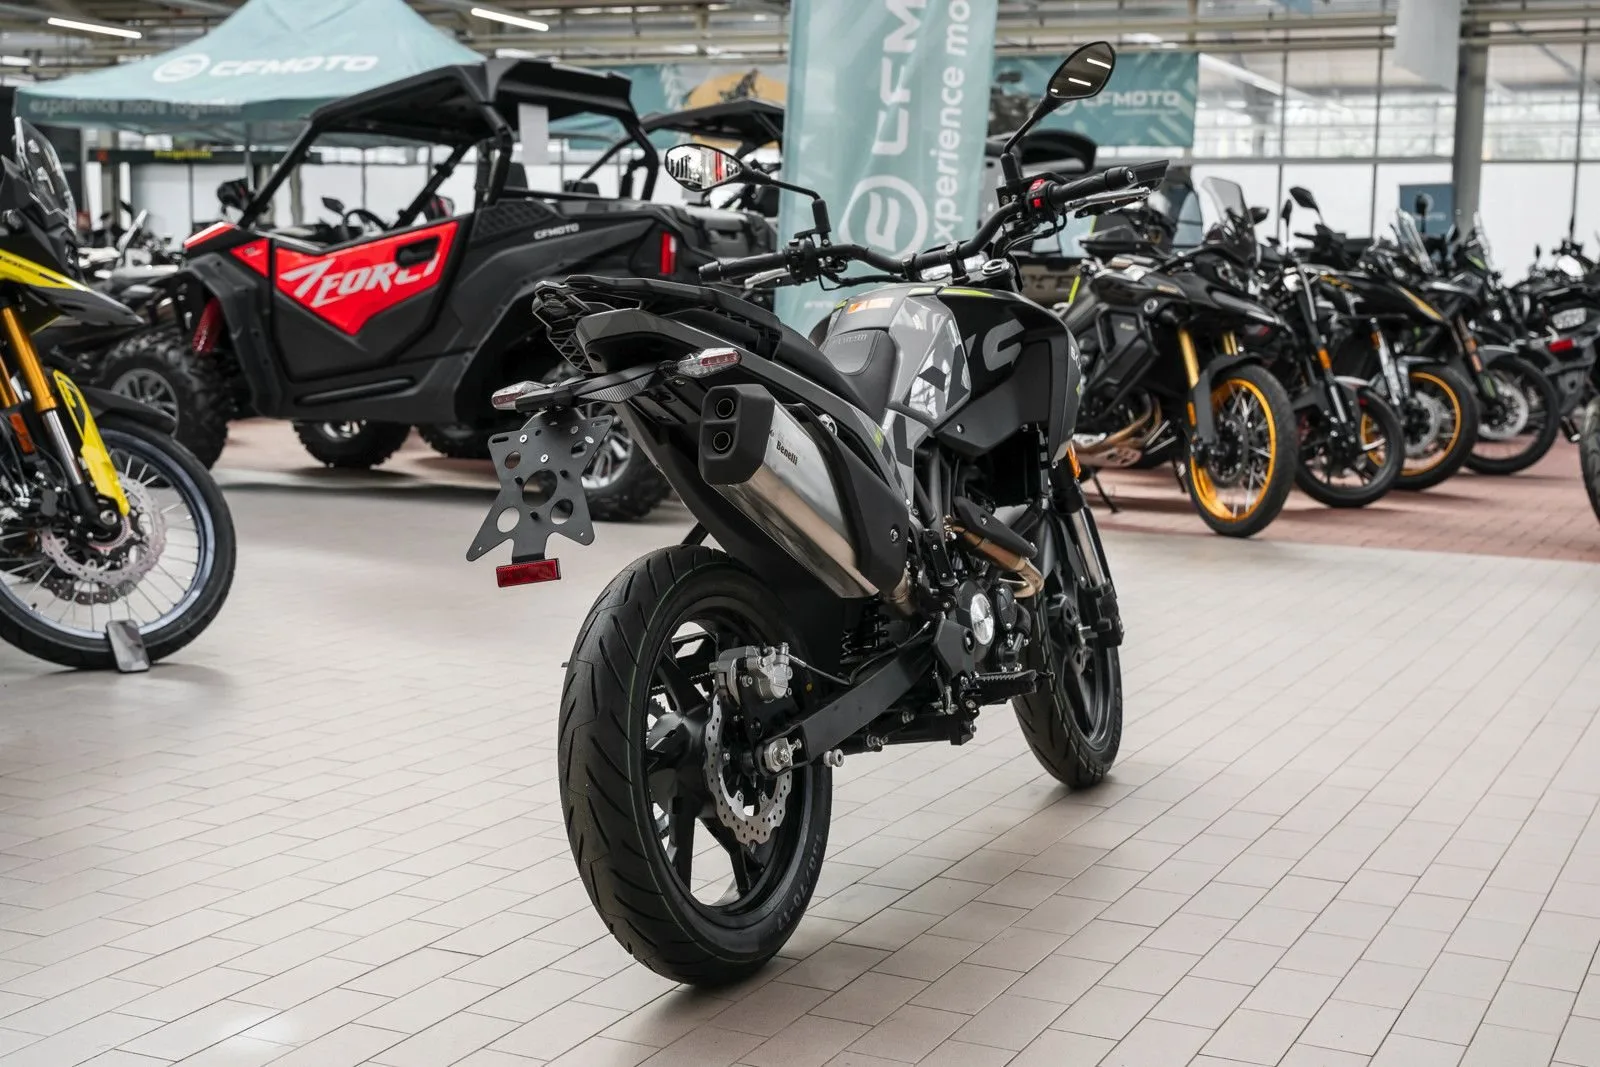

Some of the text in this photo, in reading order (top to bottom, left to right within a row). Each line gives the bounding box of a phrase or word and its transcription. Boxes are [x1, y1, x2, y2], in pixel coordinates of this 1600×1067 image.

[208, 54, 380, 77] CFMOTO
[932, 66, 966, 246] xperience
[776, 440, 799, 466] Benelli
